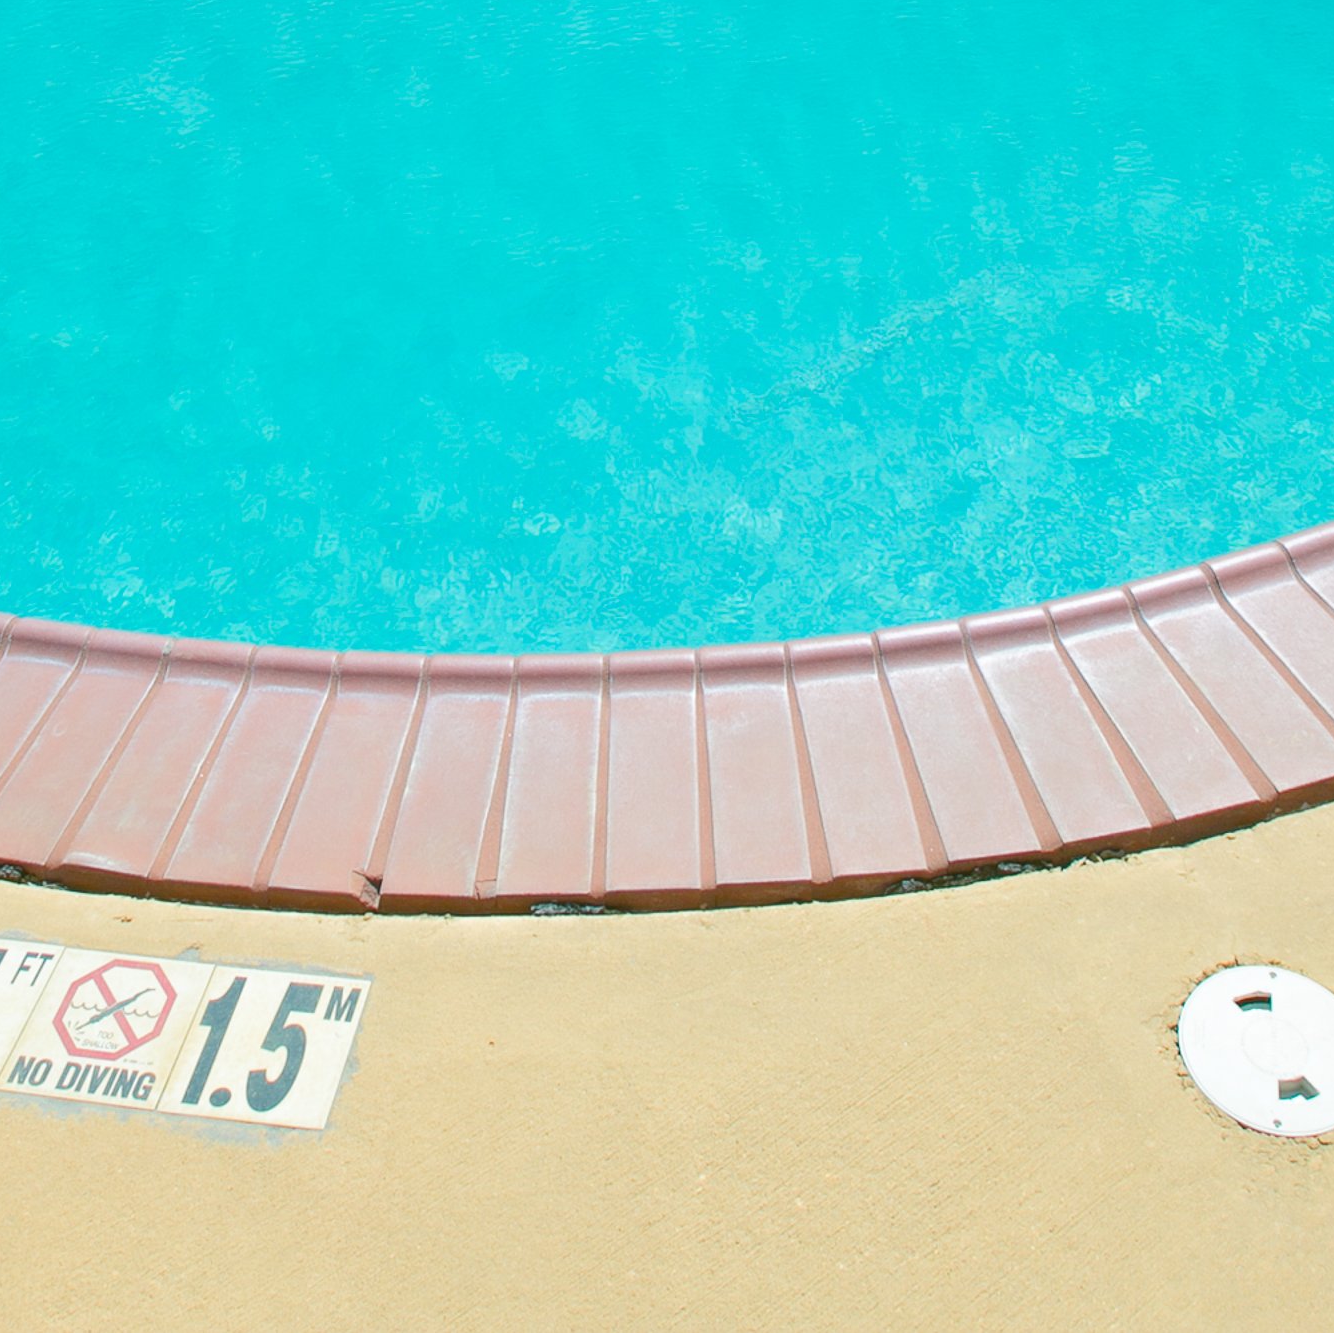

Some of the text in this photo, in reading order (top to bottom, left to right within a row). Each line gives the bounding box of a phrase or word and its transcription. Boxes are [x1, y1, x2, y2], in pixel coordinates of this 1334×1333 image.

[11, 952, 55, 987] FT
[181, 977, 362, 1113] 1.5 M
[7, 1055, 156, 1101] NO DIVING
